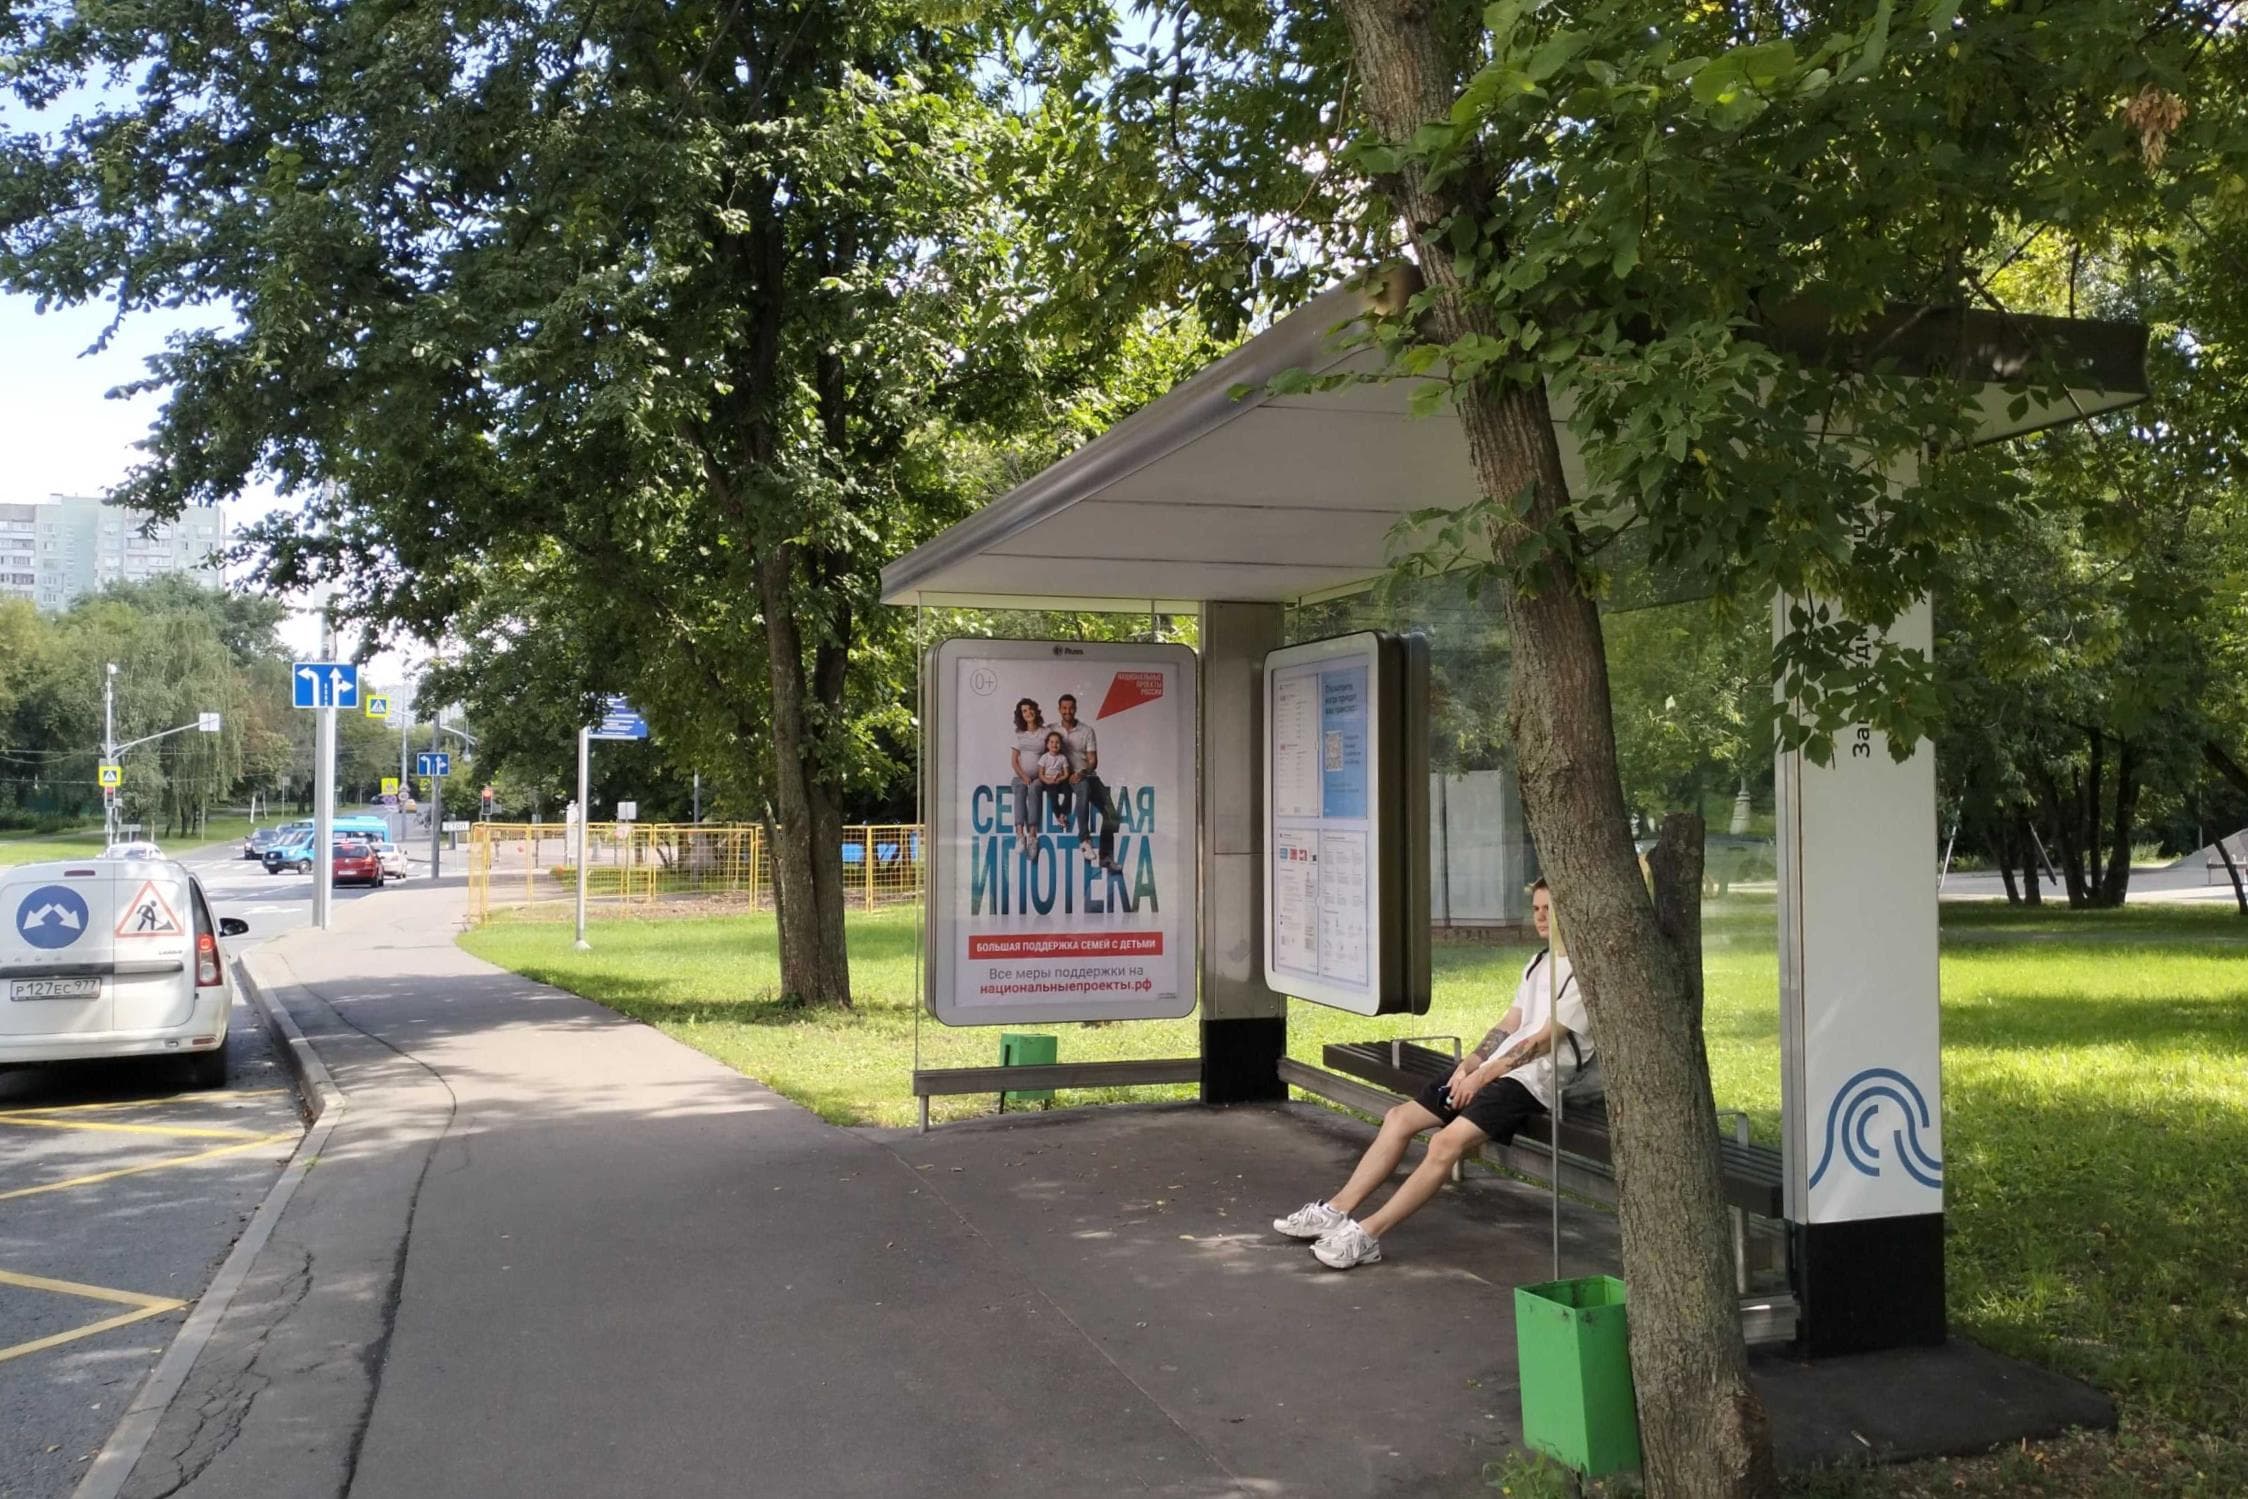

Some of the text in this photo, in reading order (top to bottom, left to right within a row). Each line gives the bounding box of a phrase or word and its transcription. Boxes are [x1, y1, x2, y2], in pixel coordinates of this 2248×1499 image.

[974, 672, 995, 690] 0+
[971, 834, 1159, 916] ИПОТЕКА
[976, 938, 1156, 952] БОЛЬШАЯ ПОДДЕРЖКА СЕМЕЙ С ДЕТЬМИ
[989, 966, 1144, 982] Все меры поддержки на
[980, 979, 1152, 995] национальныепроекты.рф
